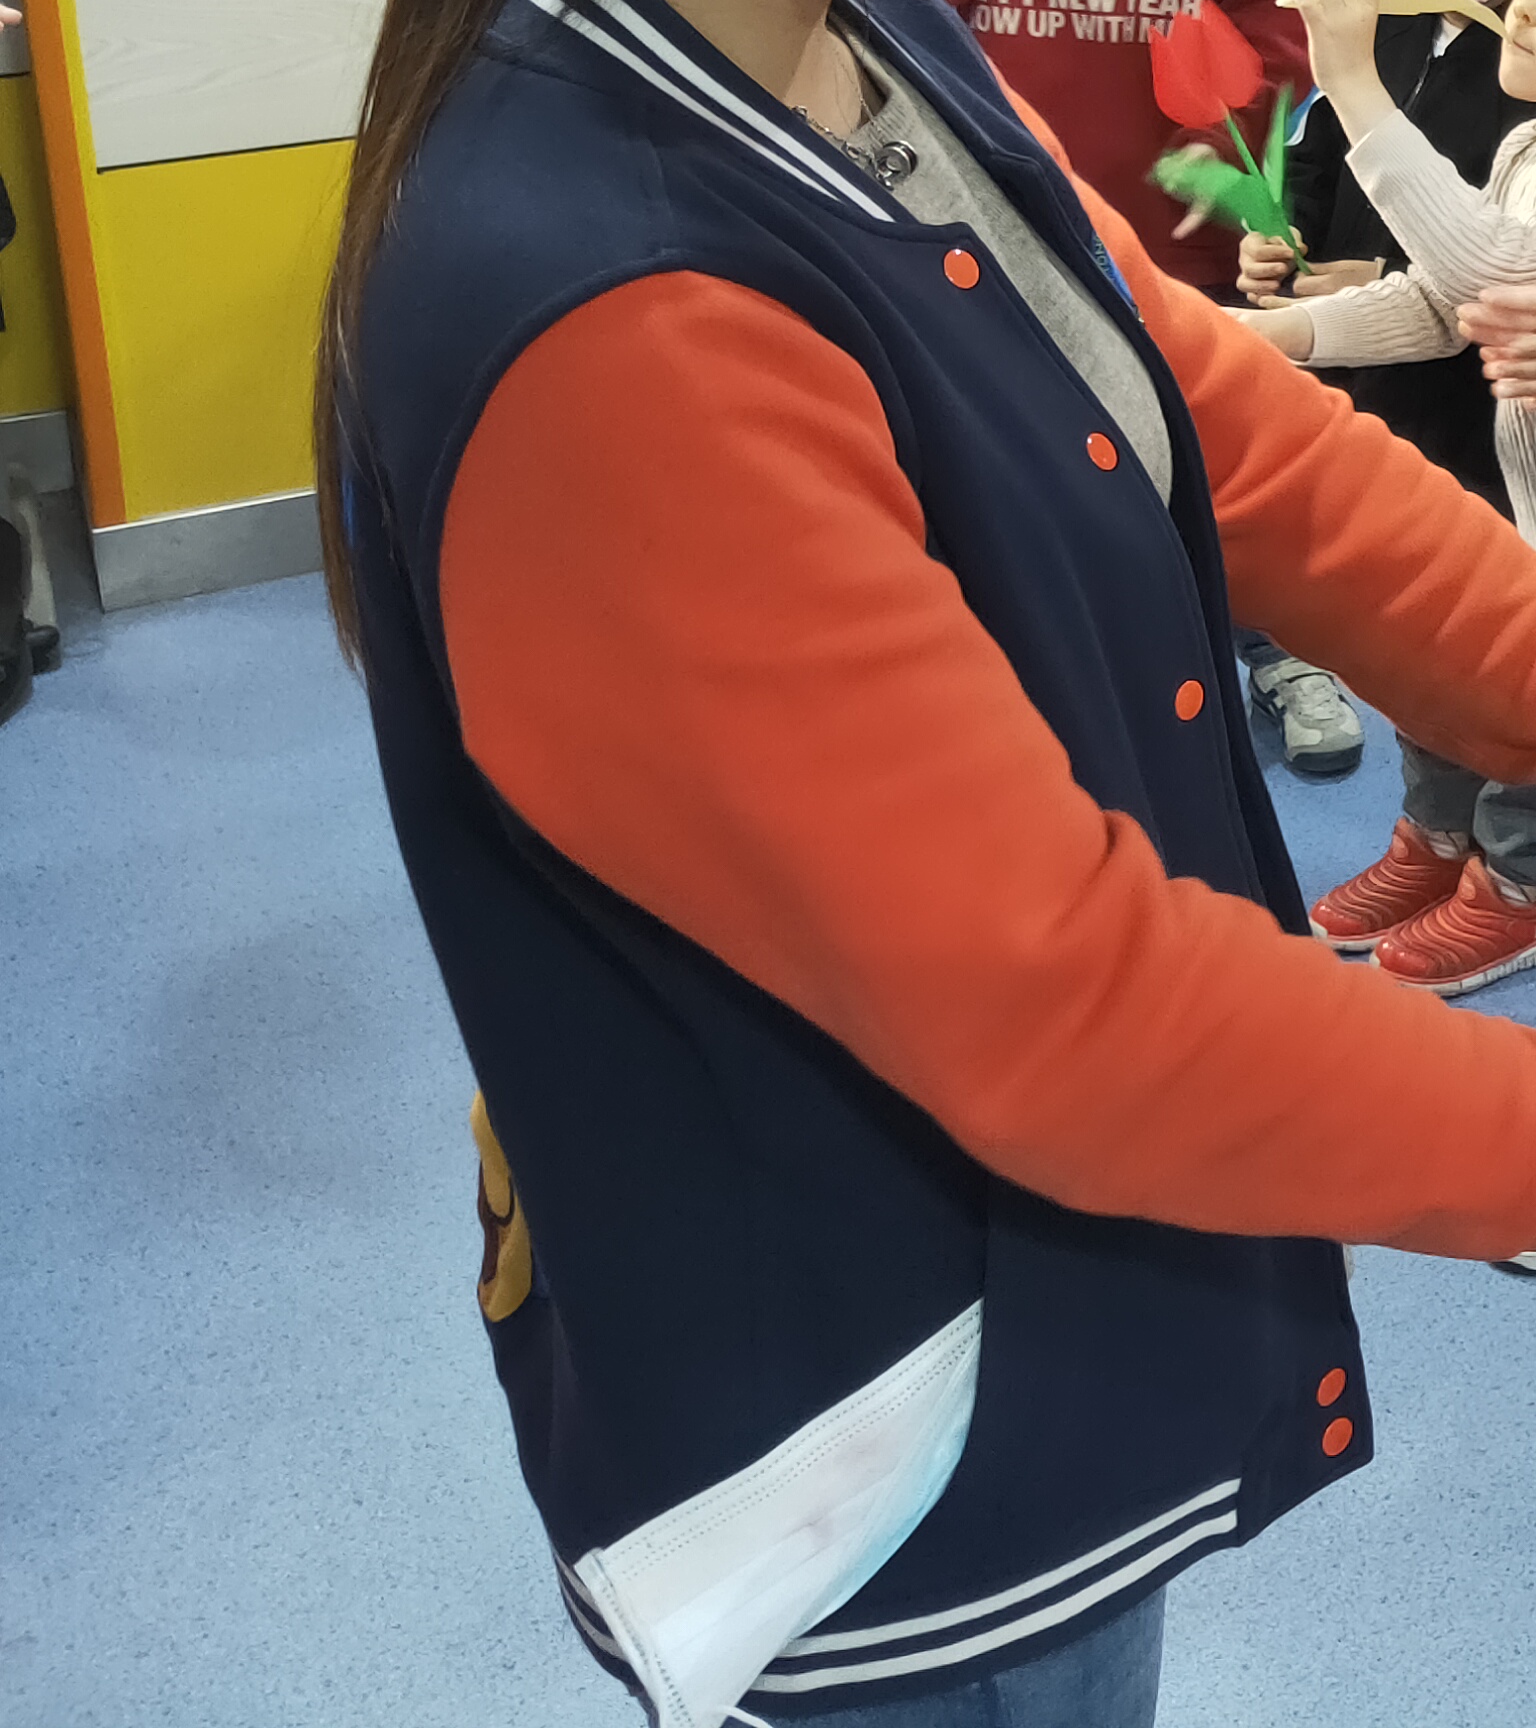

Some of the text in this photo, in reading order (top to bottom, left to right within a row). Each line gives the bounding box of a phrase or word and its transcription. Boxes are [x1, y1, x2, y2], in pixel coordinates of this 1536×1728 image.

[971, 4, 1022, 35] OW
[1027, 9, 1067, 38] UP
[1070, 12, 1136, 43] WITH
